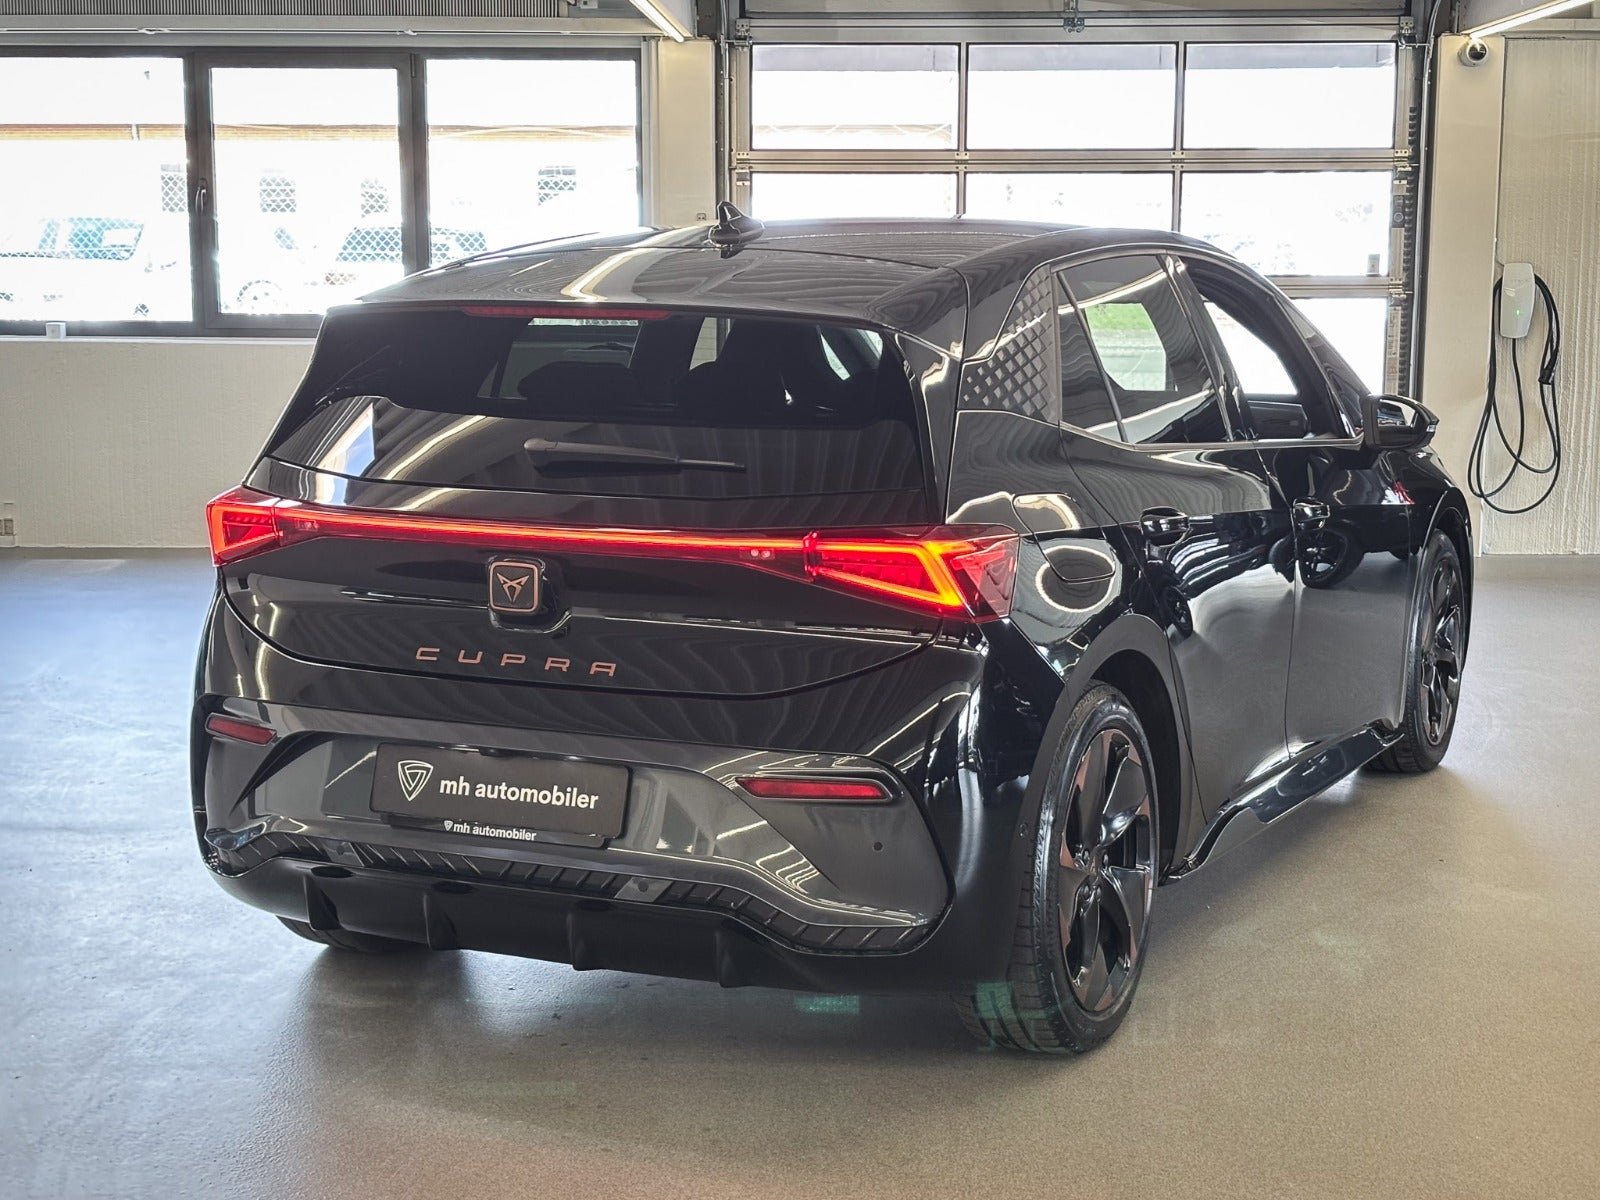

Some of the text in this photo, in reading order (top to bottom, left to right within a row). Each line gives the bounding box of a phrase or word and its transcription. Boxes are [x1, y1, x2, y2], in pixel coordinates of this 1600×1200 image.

[415, 646, 617, 677] CUPRA
[440, 776, 599, 809] mh automobiler
[453, 822, 537, 841] mh automobiler
